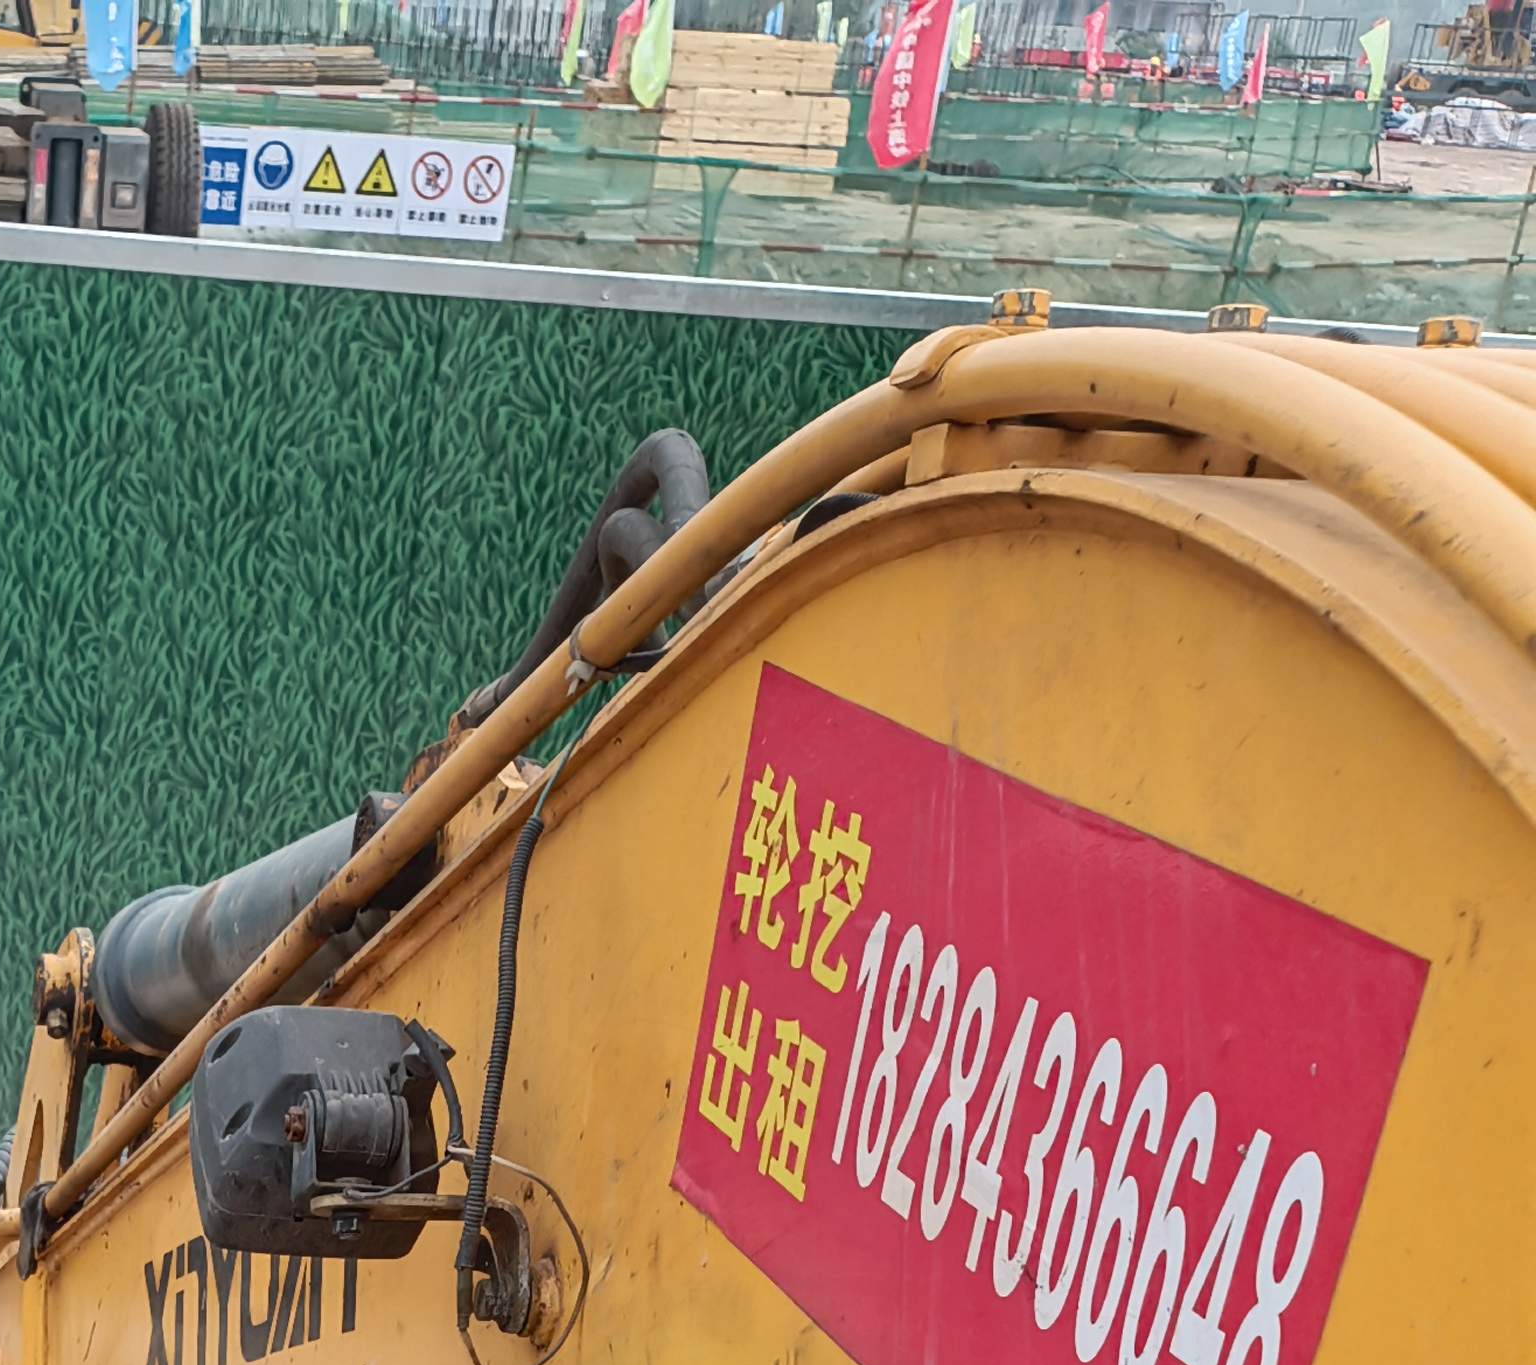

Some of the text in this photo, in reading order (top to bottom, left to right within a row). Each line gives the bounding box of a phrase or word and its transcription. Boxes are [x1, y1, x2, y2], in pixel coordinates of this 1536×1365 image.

[202, 160, 241, 183] 危险
[733, 764, 872, 995] 轮挖
[697, 980, 830, 1203] 出租
